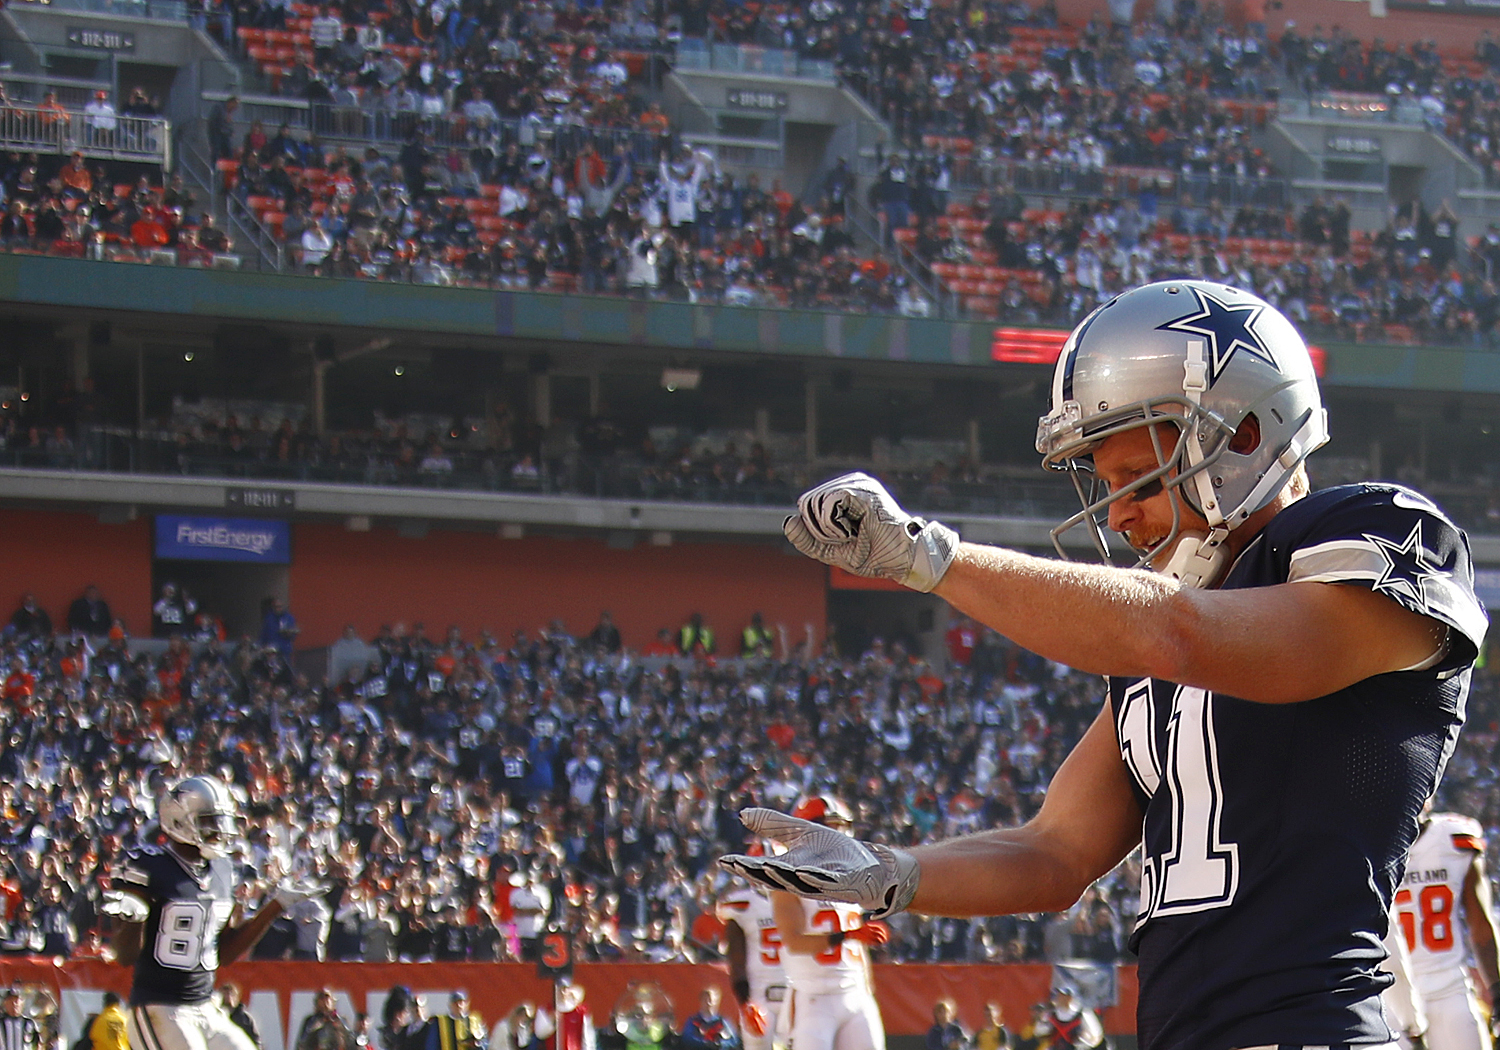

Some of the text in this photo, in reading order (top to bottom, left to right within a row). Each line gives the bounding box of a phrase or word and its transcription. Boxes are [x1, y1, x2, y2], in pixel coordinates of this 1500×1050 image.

[176, 525, 276, 552] FirstEnergy
[1118, 677, 1240, 932] 11
[541, 934, 570, 969] 3
